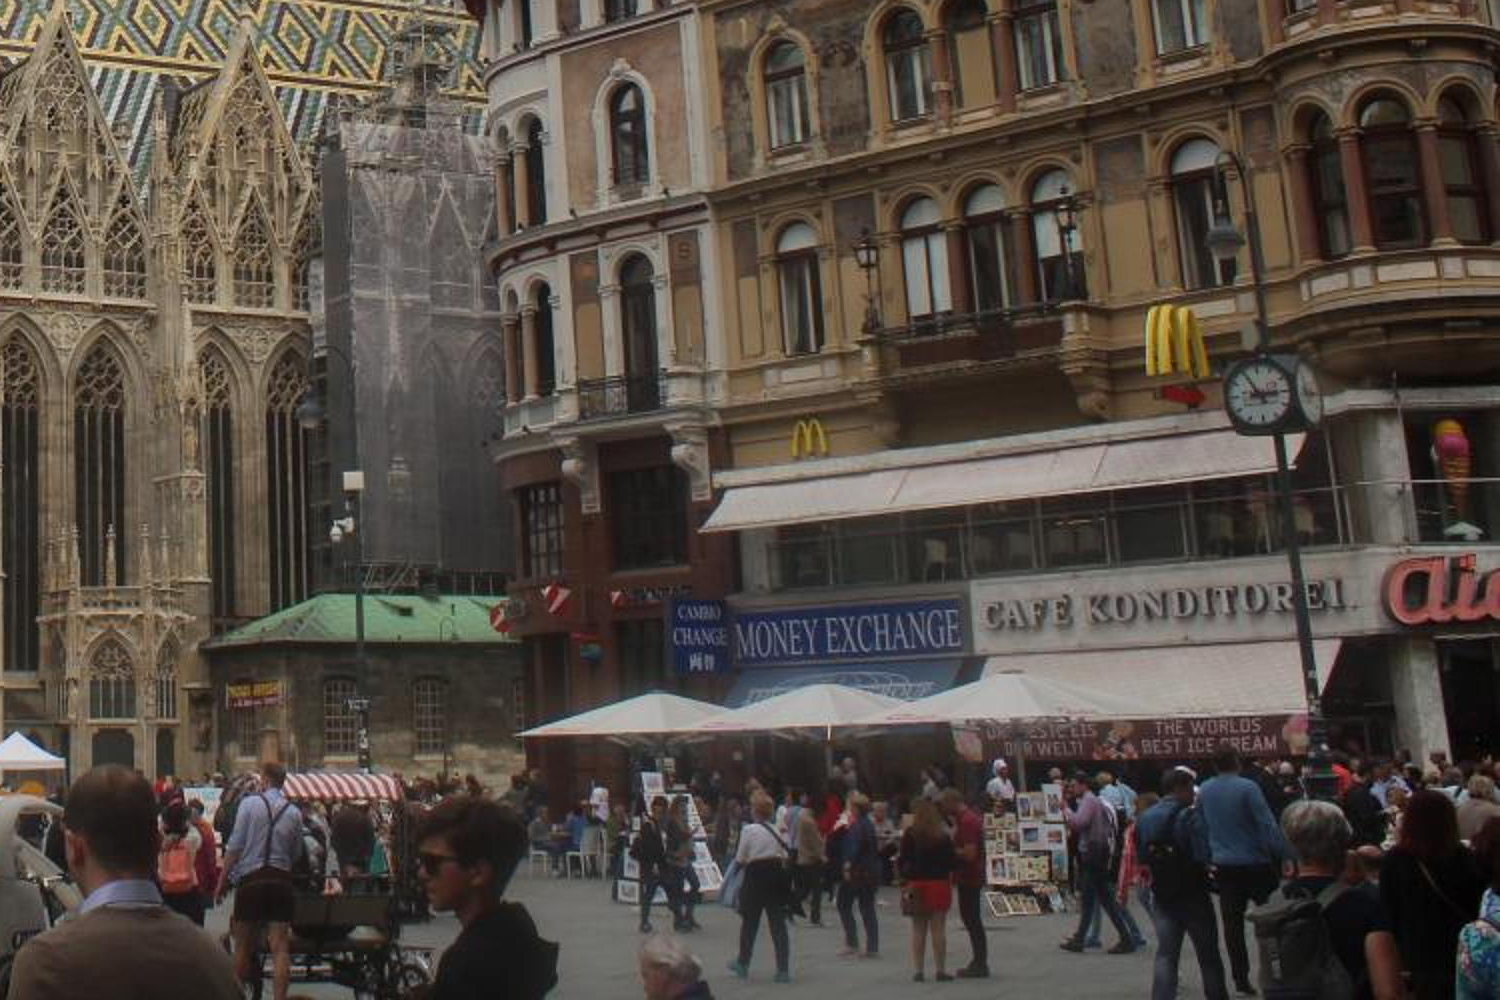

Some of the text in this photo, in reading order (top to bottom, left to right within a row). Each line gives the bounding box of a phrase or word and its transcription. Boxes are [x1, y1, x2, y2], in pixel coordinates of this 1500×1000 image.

[1085, 578, 1344, 625] KONDITOREI
[677, 604, 722, 621] CAMBIO
[672, 627, 728, 647] CHANGE
[735, 608, 963, 660] MONEY EXCHANGE
[1154, 719, 1186, 736] THE
[1140, 738, 1185, 755] BEST
[1187, 737, 1214, 753] ICE
